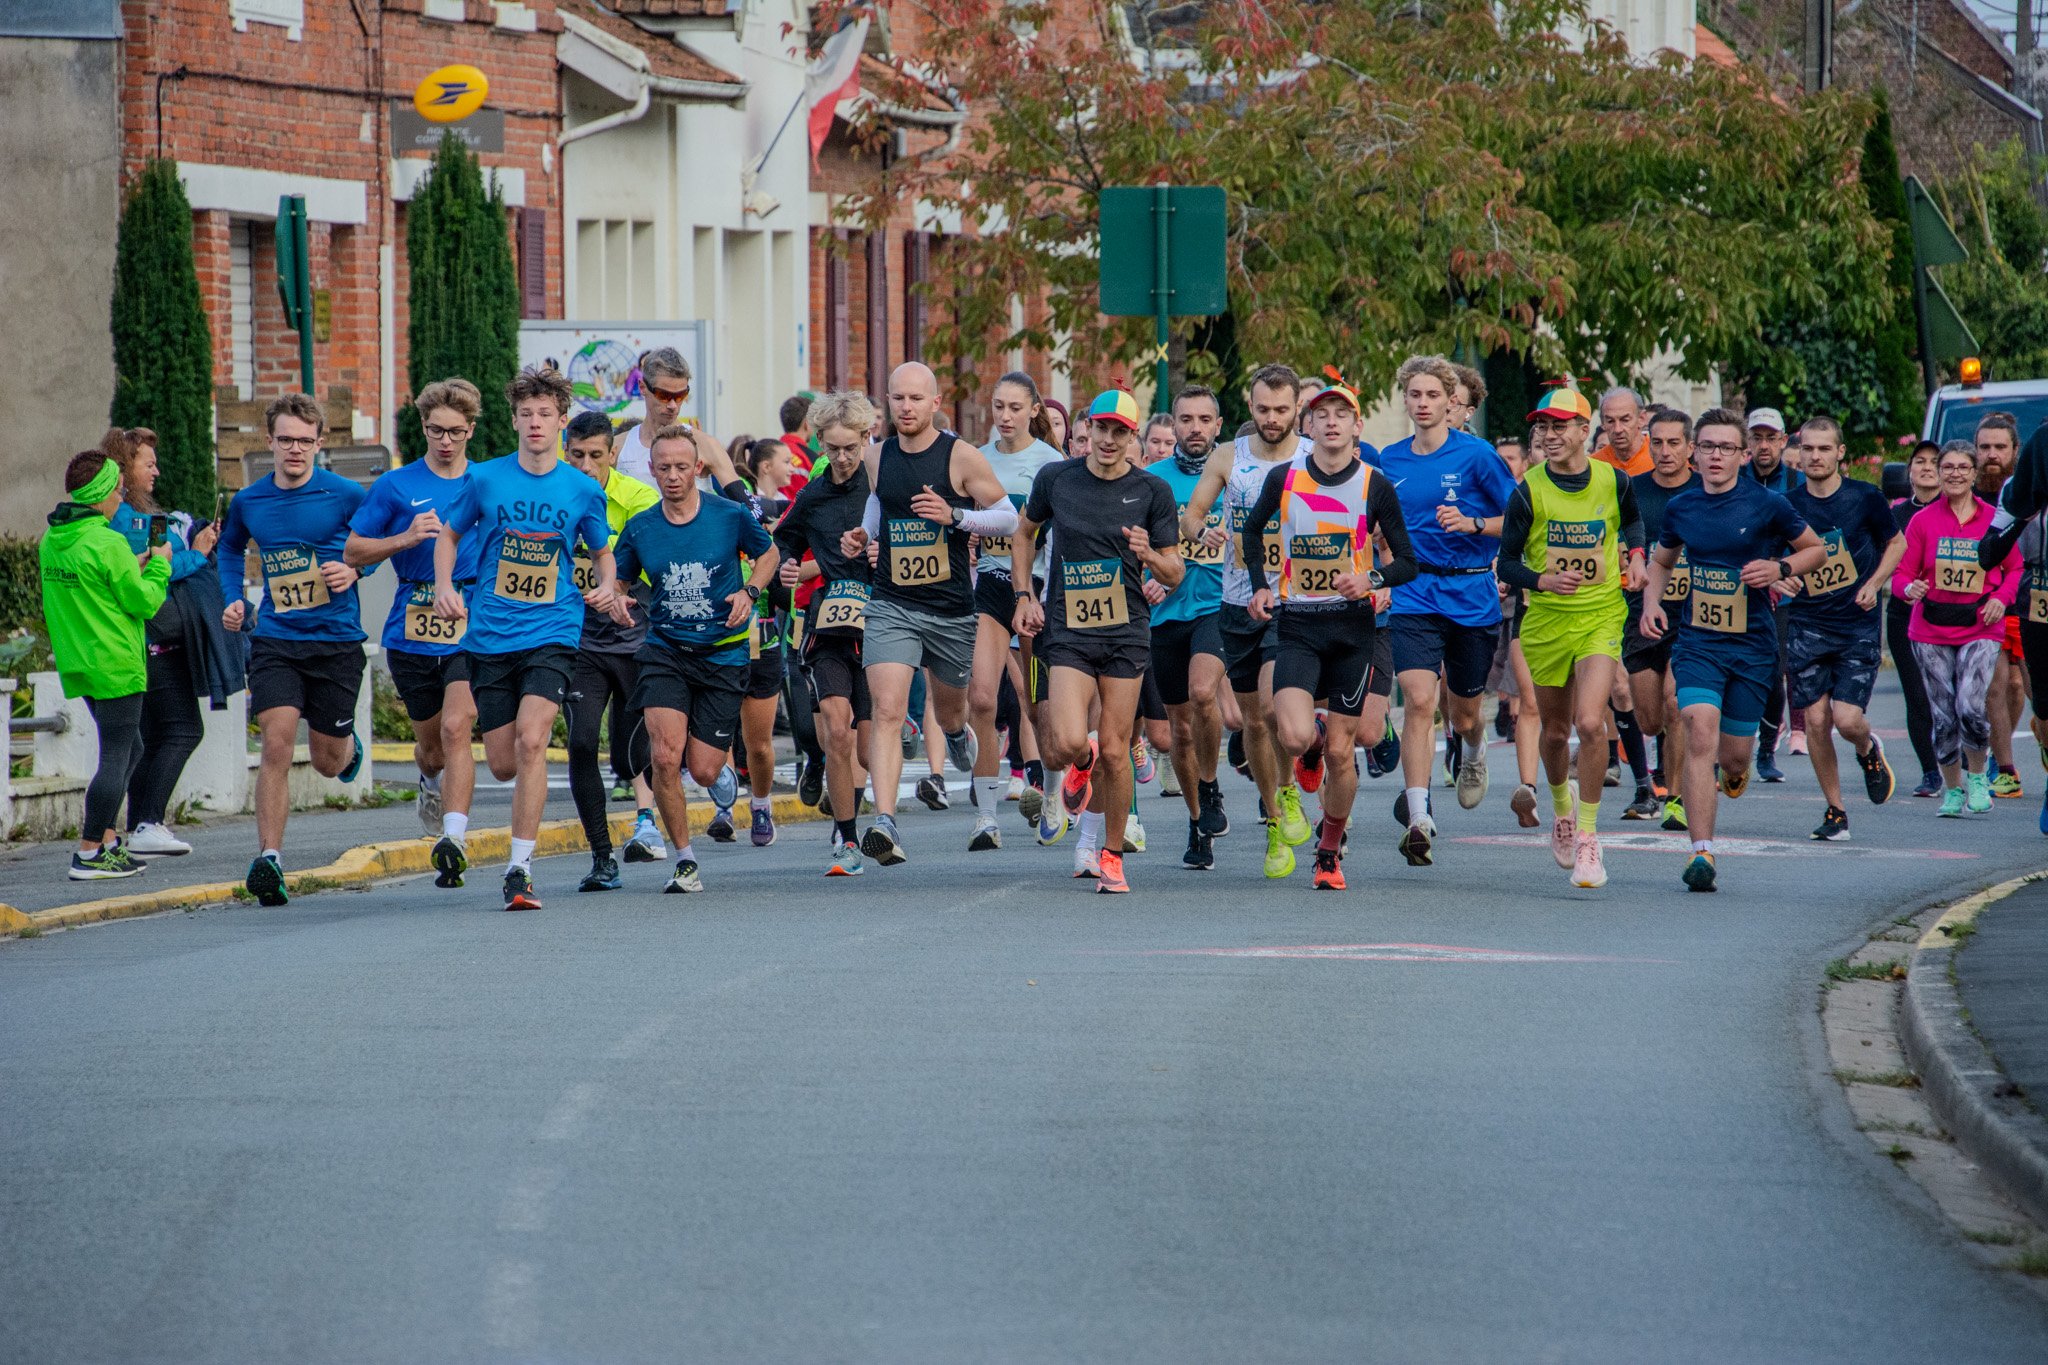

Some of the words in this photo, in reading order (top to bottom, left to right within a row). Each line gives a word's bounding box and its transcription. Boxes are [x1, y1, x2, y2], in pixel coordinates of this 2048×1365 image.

[496, 500, 569, 530] ASICS
[889, 522, 902, 532] LA
[1549, 522, 1562, 533] LA
[504, 536, 518, 549] LA
[891, 532, 904, 542] DU
[905, 531, 936, 542] NORD
[1291, 536, 1304, 547] LA
[1548, 533, 1564, 543] DU
[1566, 534, 1597, 544] NORD
[1938, 539, 1951, 548] LA
[502, 546, 518, 558] DU
[520, 551, 551, 563] NORD
[1291, 545, 1307, 555] DU
[1309, 545, 1340, 556] NORD
[1937, 547, 1951, 556] DU
[1952, 548, 1979, 559] NORD
[263, 553, 275, 564] LA
[266, 563, 279, 573] DU
[280, 557, 309, 571] NORD
[899, 555, 940, 580] 320
[1064, 565, 1077, 575] LA
[1693, 566, 1703, 577] LA
[1065, 575, 1079, 585] DU
[1081, 573, 1112, 585] NORD
[1811, 563, 1850, 590] 322
[1942, 567, 1978, 589] 347
[504, 572, 548, 598] 346
[831, 582, 843, 591] LA
[1665, 576, 1689, 596] 56
[1693, 576, 1705, 587] DU
[1706, 581, 1736, 591] NORD
[279, 580, 316, 607] 317
[668, 588, 705, 598] CASSEL
[843, 588, 871, 601] NORD
[826, 604, 863, 624] 337
[1076, 596, 1115, 623] 341
[1699, 601, 1733, 627] 351
[414, 613, 456, 639] 353
